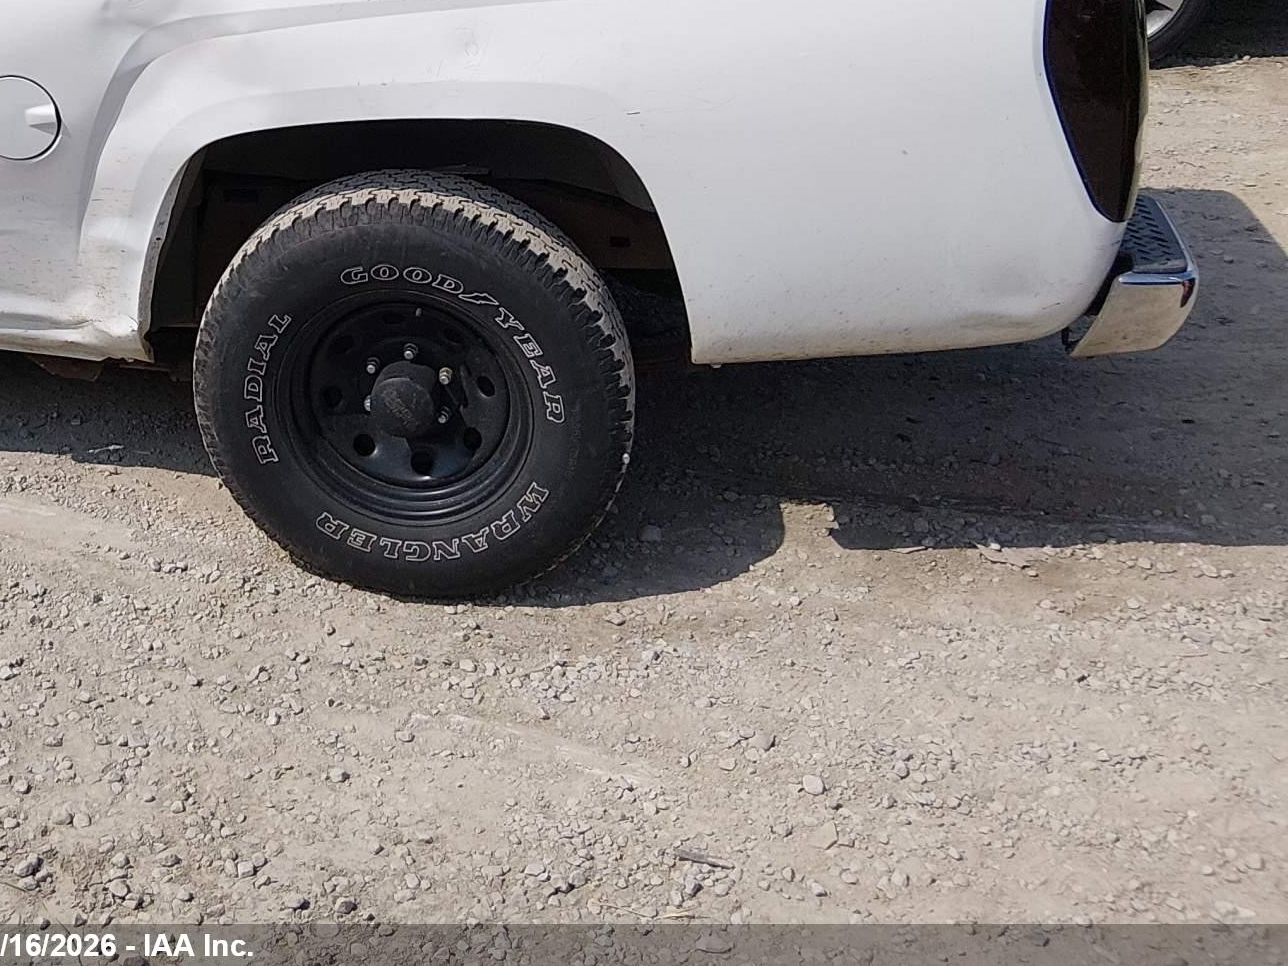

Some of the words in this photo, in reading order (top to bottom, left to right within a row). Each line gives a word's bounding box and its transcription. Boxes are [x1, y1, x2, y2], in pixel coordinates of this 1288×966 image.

[243, 312, 292, 465] RADIAL
[340, 264, 567, 424] GOODYEAR
[315, 482, 550, 562] WRANGLER
